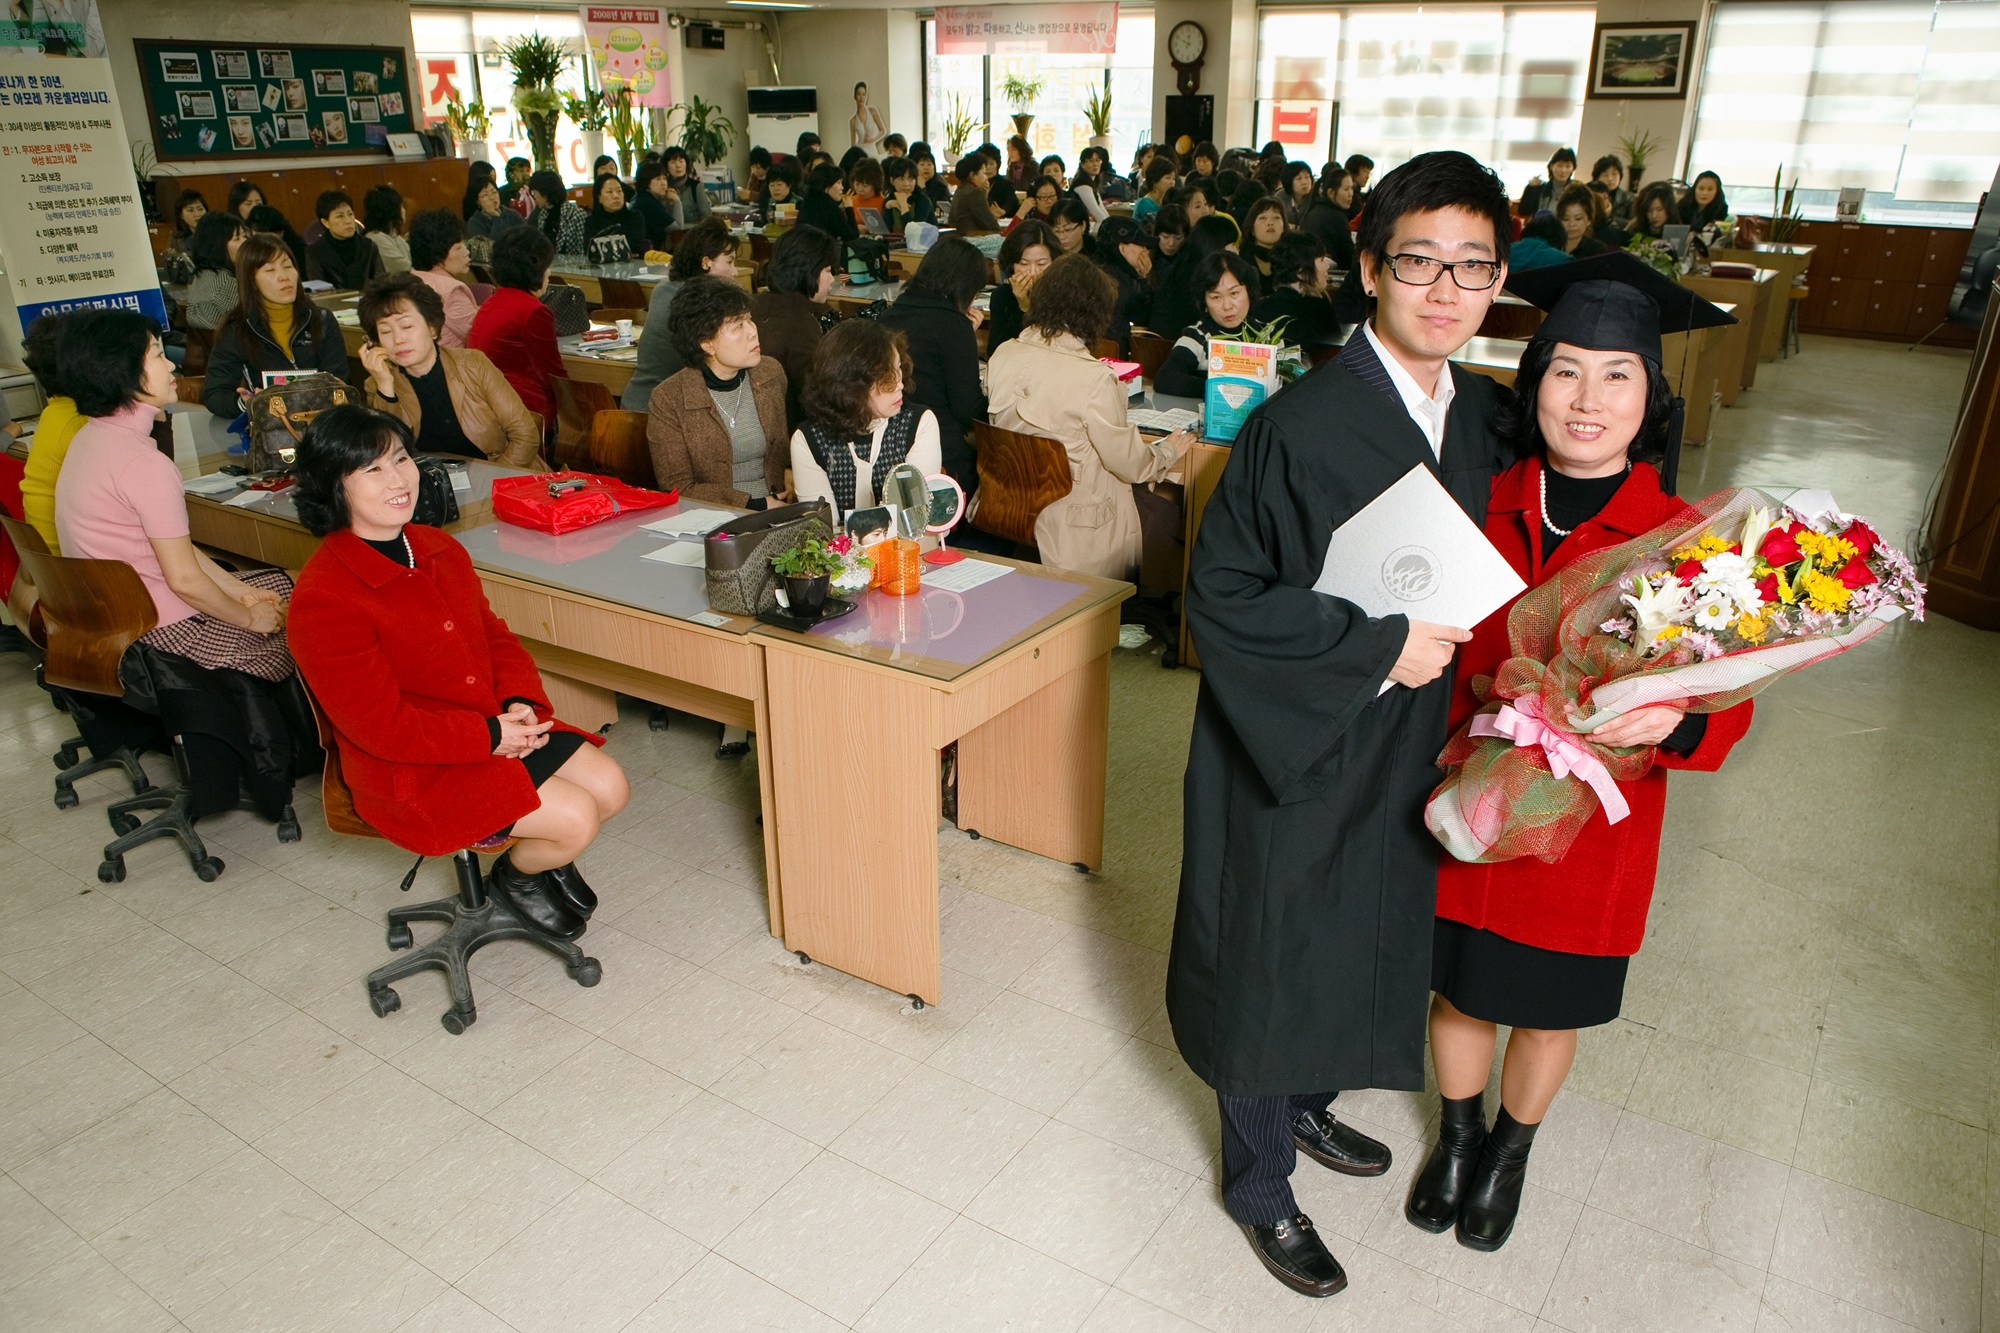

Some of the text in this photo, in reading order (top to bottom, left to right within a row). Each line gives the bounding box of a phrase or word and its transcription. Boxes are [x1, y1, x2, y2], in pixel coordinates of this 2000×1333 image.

[592, 10, 617, 21] 2008년
[2, 27, 30, 41] 당당한
[946, 25, 964, 35] 모두가
[965, 23, 983, 36] 밝고,
[984, 23, 1013, 36] 따뜻하고,
[1014, 22, 1036, 35] 신나는
[1037, 23, 1071, 35] 영업장으로
[27, 76, 38, 89] 한
[40, 76, 64, 89] 50년,
[0, 91, 111, 106] 는 아모레 카운셀러입니다.
[8, 122, 24, 132] 30세
[24, 121, 43, 131] 이상의
[44, 120, 68, 131] 활동적인
[69, 120, 81, 130] 여성
[82, 121, 87, 129] &
[88, 119, 112, 129] 주부사원
[2, 146, 10, 156] 전
[22, 144, 53, 155] 무자본으로
[54, 143, 72, 153] 시작할
[73, 143, 79, 152] 수
[80, 142, 92, 152] 있는
[31, 154, 78, 166] 여성 최고의 사업
[21, 171, 62, 183] 2. 고소득 보장
[28, 195, 134, 211] 3. 직급에 의한 승진 및 추가 소득혜택 부여
[64, 211, 75, 219] 따라
[76, 210, 97, 219] 언제든지
[98, 208, 109, 217] 직급
[36, 225, 99, 238] 4. 미용자격증 취득 보장
[39, 242, 79, 255] 5. 다양한 혜택
[36, 277, 44, 286] 타
[68, 271, 92, 282] 메이크업
[92, 269, 116, 280] 무료강좌
